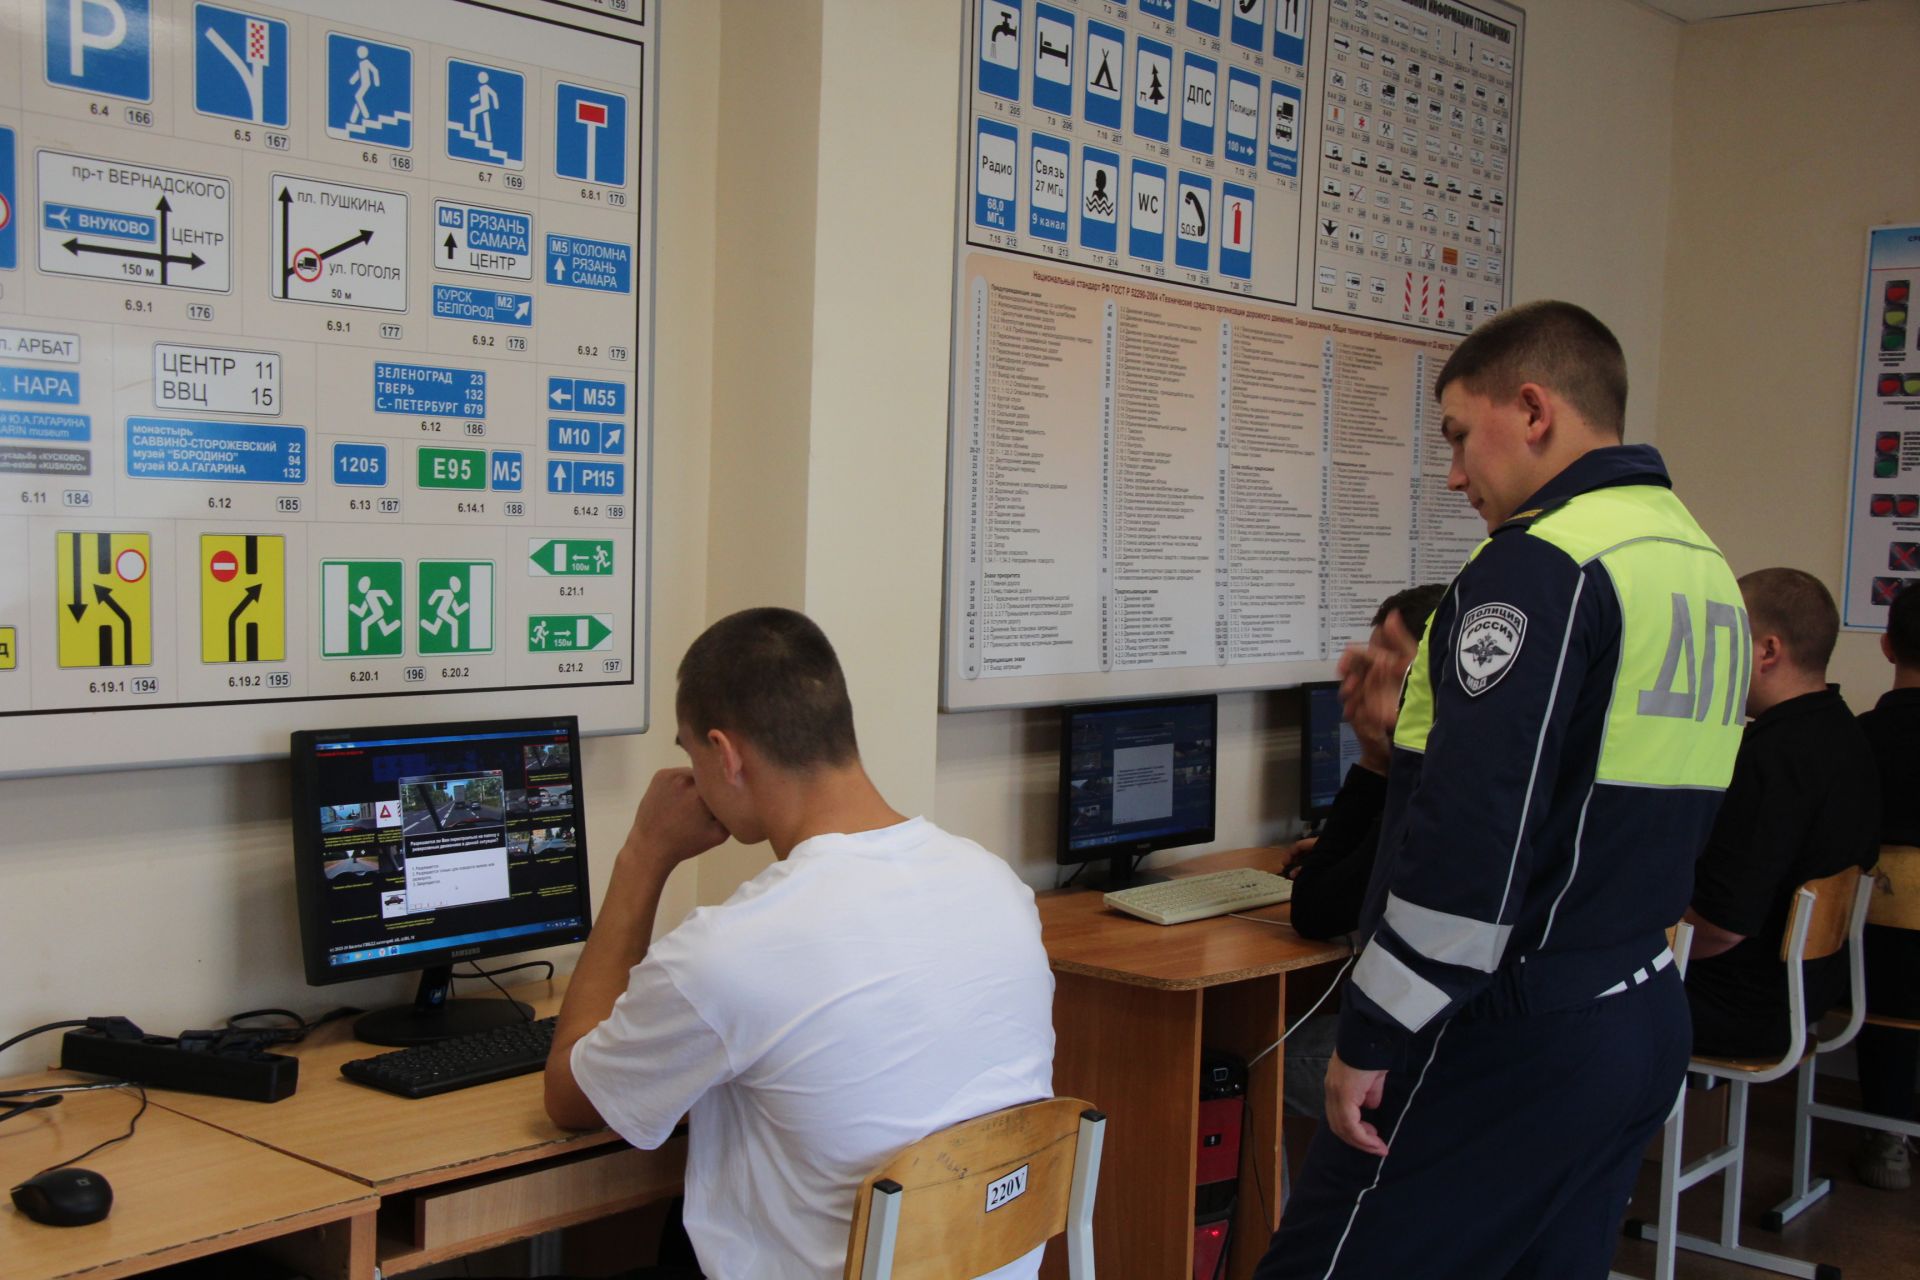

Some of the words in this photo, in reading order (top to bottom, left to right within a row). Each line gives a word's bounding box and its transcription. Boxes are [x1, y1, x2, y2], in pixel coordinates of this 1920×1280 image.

[1187, 84, 1212, 106] ДПС
[90, 103, 109, 117] 6.4
[1229, 99, 1256, 118] Полиция
[128, 110, 150, 124] 166
[235, 129, 251, 142] 6.5
[267, 135, 287, 148] 167
[363, 152, 377, 164] 6.6
[392, 157, 410, 169] 168
[982, 156, 1013, 176] Радио
[1035, 159, 1065, 179] Связь
[72, 165, 104, 181] пр-т
[109, 169, 225, 200] ВЕРНАДСКОГО
[479, 172, 492, 183] 6.7
[506, 175, 522, 188] 169
[581, 189, 600, 200] 6.8.1
[1035, 180, 1045, 192] 27
[1047, 182, 1064, 197] МГц
[297, 191, 316, 204] пл.
[320, 192, 385, 214] ПУШКИНА
[609, 193, 624, 205] 170
[1138, 192, 1158, 214] WC
[441, 207, 461, 226] M5
[987, 212, 1005, 227] МГц
[1032, 213, 1037, 224] 9
[1040, 217, 1065, 231] канал
[78, 213, 150, 236] ВНУКОВО
[470, 213, 525, 234] РЯЗАНЬ
[172, 227, 224, 247] ЦЕНТР
[470, 231, 526, 252] САМАРА
[990, 234, 1001, 243] 7.15
[1006, 236, 1017, 246] 212
[573, 243, 627, 261] КОЛОМНА
[470, 252, 516, 271] ЦЕНТР
[573, 258, 616, 275] РЯЗАНЬ
[1108, 257, 1118, 266] 214
[121, 263, 142, 276] 150
[329, 264, 346, 275] ул.
[351, 263, 400, 281] ГОГОЛЯ
[1155, 267, 1165, 276] 215
[573, 271, 617, 289] САМАРА
[332, 289, 342, 299] 50
[437, 289, 472, 303] КУРСК
[1110, 284, 1126, 296] ГОСТ
[125, 299, 152, 313] 6.9.1
[190, 305, 210, 319] 176
[437, 301, 494, 320] БЕЛГОРОД
[327, 320, 350, 333] 6.9.1
[382, 326, 400, 338] 177
[18, 338, 73, 356] АРБАТ
[472, 335, 494, 347] 6.9.2
[509, 338, 524, 351] 178
[578, 345, 598, 357] 6.9.2
[611, 348, 626, 361] 179
[162, 354, 236, 376] ЦЕНТР
[255, 362, 273, 380] 11
[377, 367, 453, 384] ЗЕЛЕНОГРАД
[470, 375, 484, 386] 23
[14, 375, 72, 397] НАРА
[377, 382, 415, 395] ТВЕРЬ
[465, 389, 483, 400] 132
[163, 382, 207, 406] ВВЦ
[251, 389, 273, 406] 15
[583, 388, 616, 407] M55
[464, 403, 484, 415] 679
[11, 414, 86, 428] Ю.А.ГАГАРИНА
[421, 421, 441, 432] 6.12
[29, 427, 70, 438] museum
[133, 425, 193, 436] монастырь
[467, 424, 483, 435] 186
[559, 428, 591, 446] M10
[133, 436, 277, 452] САВВИНО-СТОРОЖЕВСКИЙ
[288, 443, 301, 453] 22
[133, 449, 165, 460] музей
[288, 456, 301, 466] 94
[133, 461, 165, 472] музей
[168, 463, 246, 474] Ю.А.ГАГАРИНА
[283, 468, 301, 479] 132
[340, 457, 379, 473] 1205
[433, 458, 471, 480] E95
[21, 492, 46, 503] 6.11
[67, 493, 89, 504] 184
[208, 498, 231, 509] 6.12
[279, 499, 299, 511] 185
[350, 500, 371, 510] 6.13
[381, 501, 398, 512] 187
[458, 503, 485, 514] 6.14.1
[506, 503, 523, 515] 188
[574, 506, 599, 517] 6.14.2
[608, 506, 624, 518] 189
[560, 587, 584, 597] 6.21.1
[1467, 607, 1521, 629] ПОЛИЦИЯ
[1467, 621, 1513, 642] РОССИЯ
[558, 663, 583, 673] 6.21.2
[604, 661, 620, 672] 197
[269, 674, 289, 686] 195
[350, 672, 379, 682] 6.20.1
[406, 669, 424, 680] 196
[442, 668, 469, 679] 6.20.2
[90, 682, 124, 693] 6.19.1
[135, 680, 156, 691] 194
[229, 676, 260, 687] 6.19.2
[1466, 676, 1487, 691] МВД
[991, 1172, 1025, 1205] 220V
